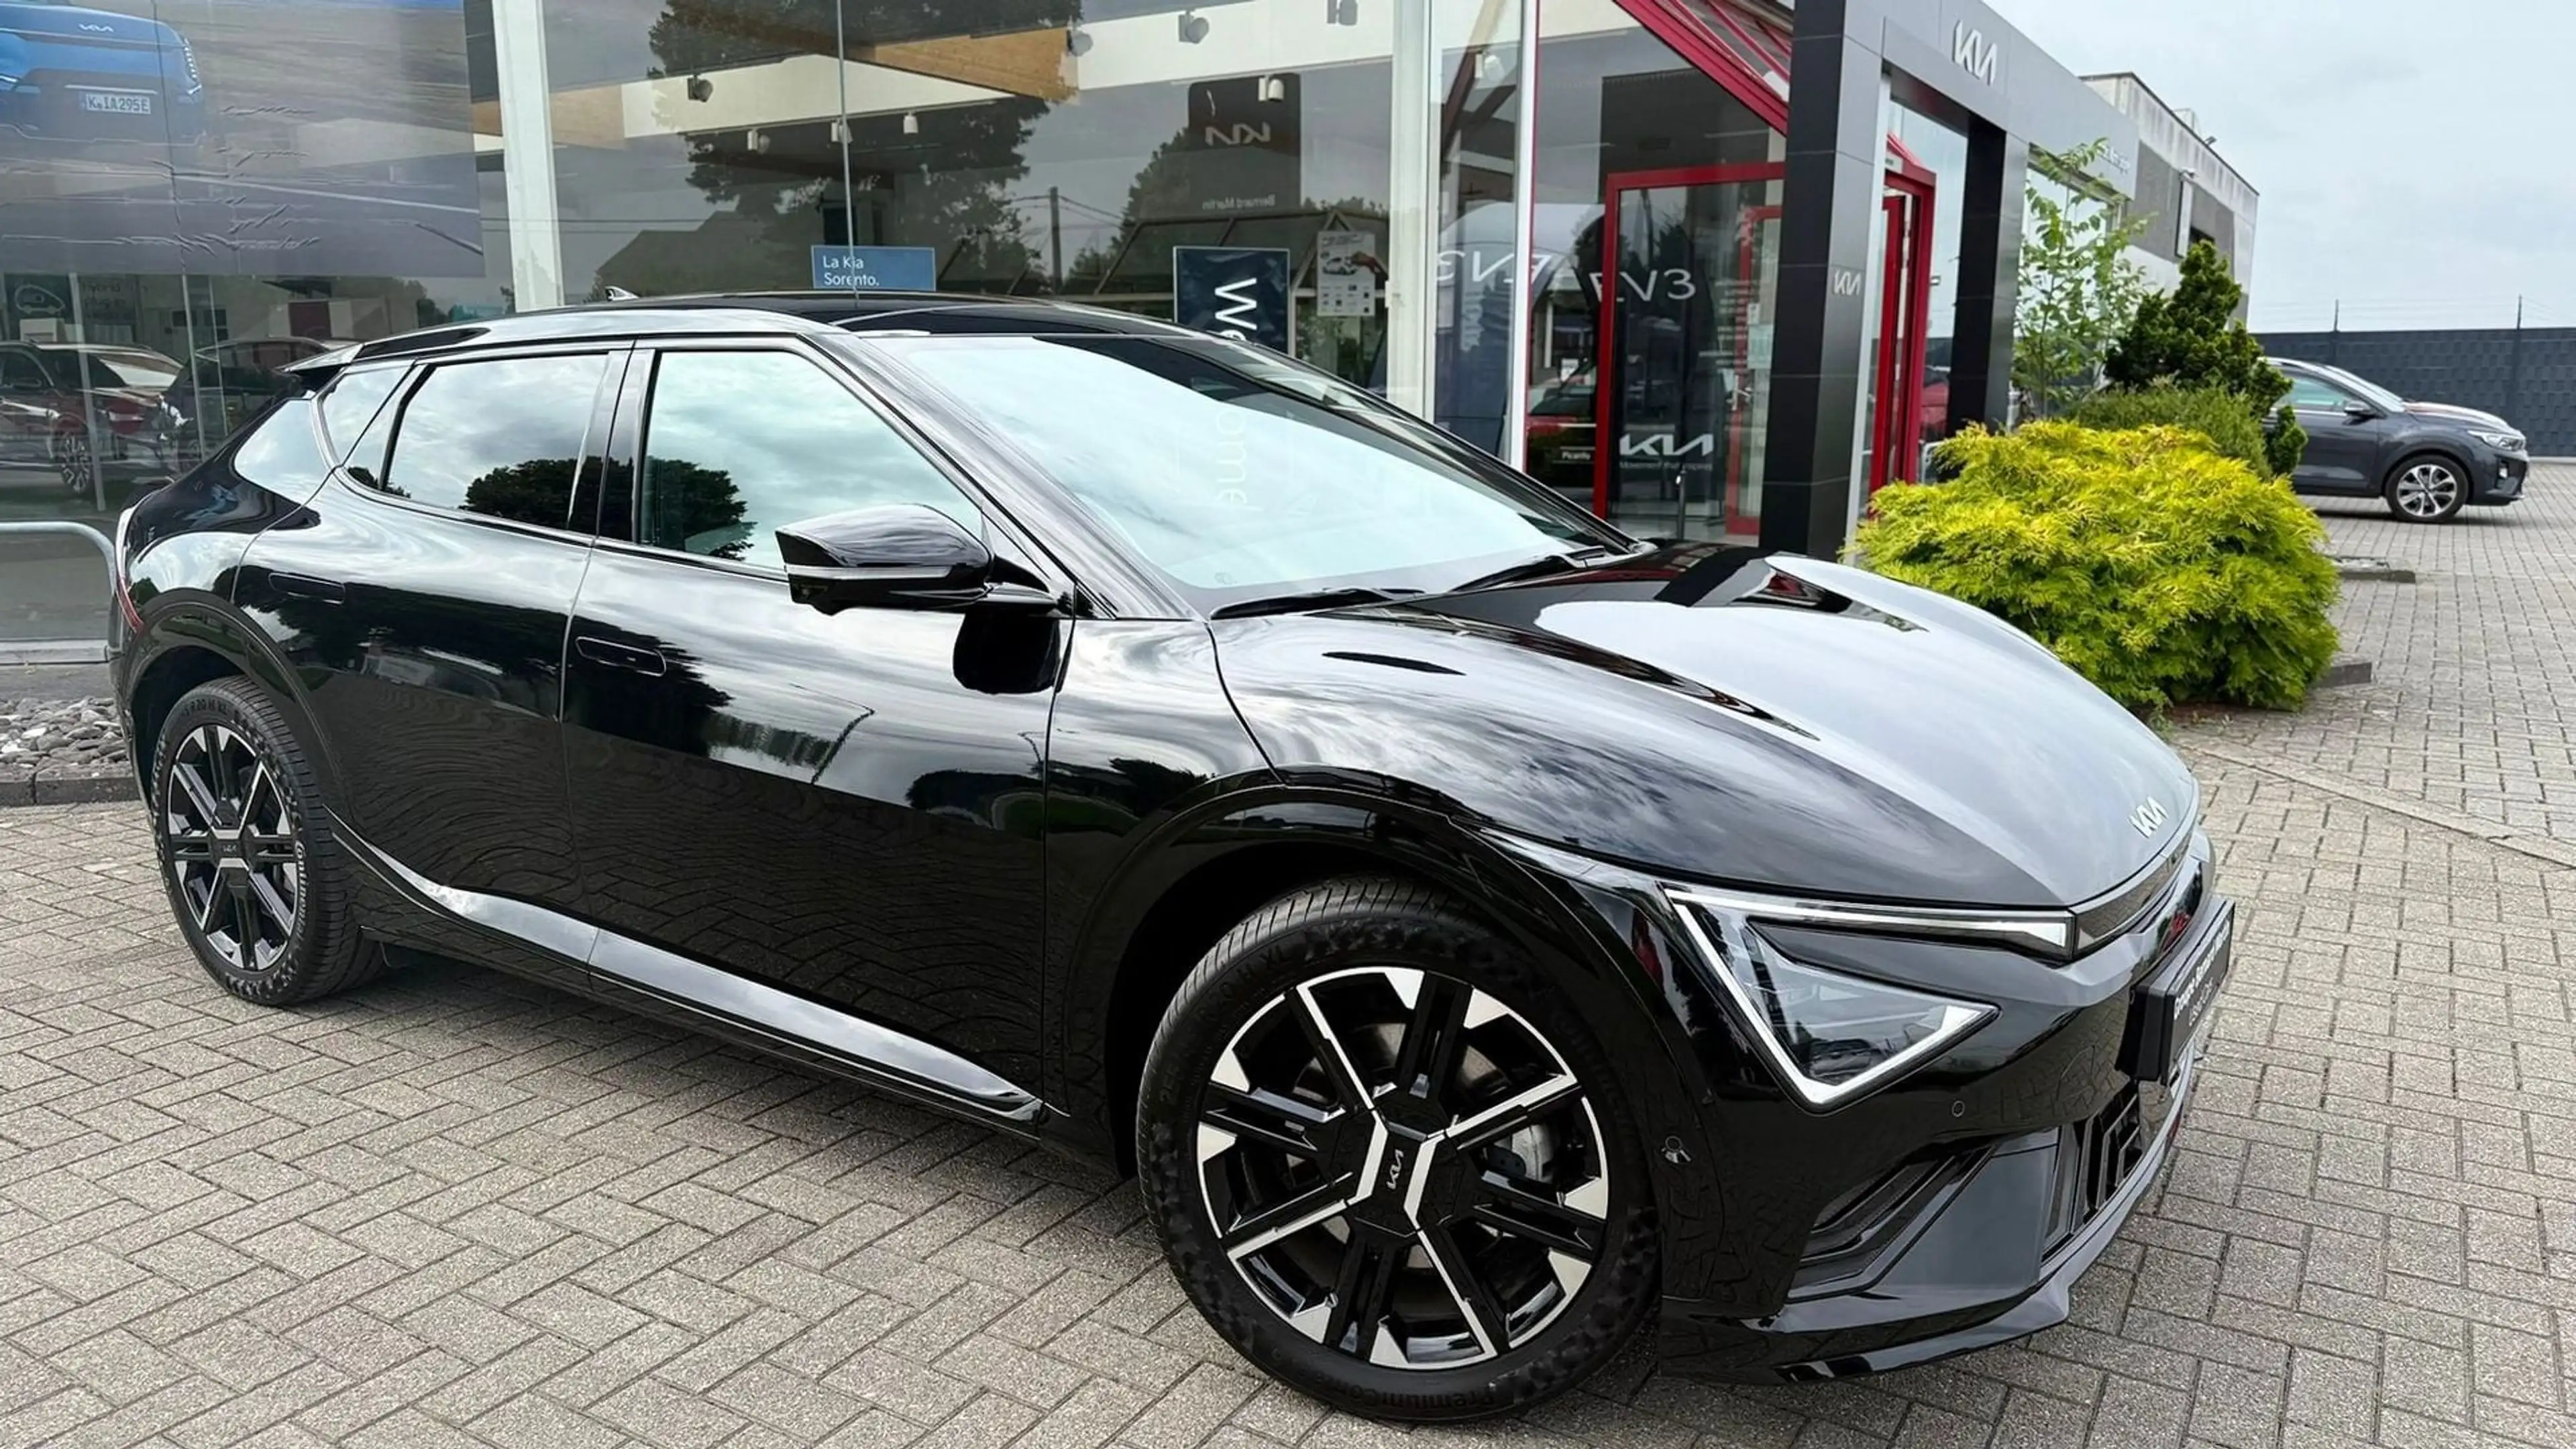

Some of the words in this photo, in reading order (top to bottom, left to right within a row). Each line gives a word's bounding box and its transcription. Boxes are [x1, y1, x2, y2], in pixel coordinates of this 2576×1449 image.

[1951, 19, 1998, 87] KIA
[822, 255, 839, 268] La
[843, 255, 864, 268] Kia
[824, 272, 880, 286] Sorento.
[1834, 269, 1861, 295] KIA
[1619, 433, 1713, 456] KIA
[2129, 796, 2169, 837] KIA
[1386, 1149, 1404, 1190] KIA
